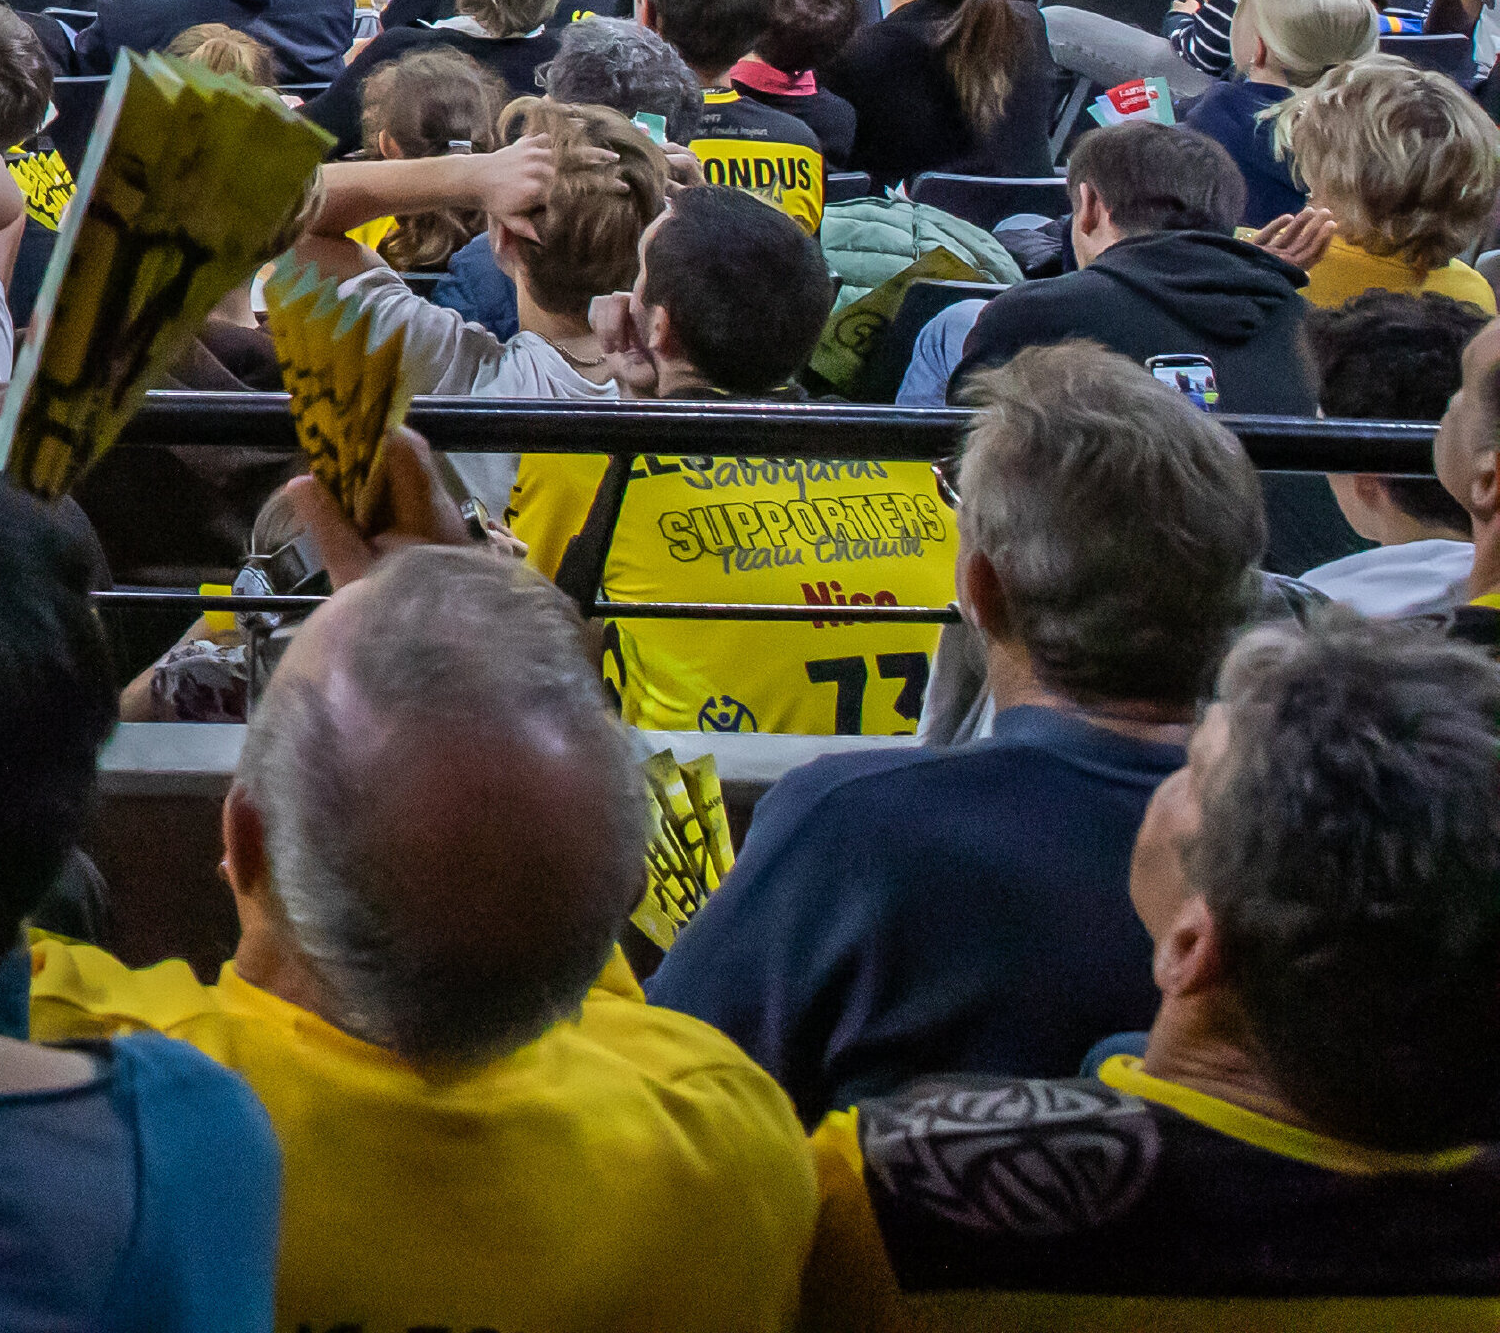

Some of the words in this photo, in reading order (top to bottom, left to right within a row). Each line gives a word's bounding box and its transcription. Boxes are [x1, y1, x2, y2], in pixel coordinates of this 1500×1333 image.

[659, 491, 947, 562] SUPPORTERS
[719, 543, 803, 576] Team
[804, 652, 929, 735] 73
